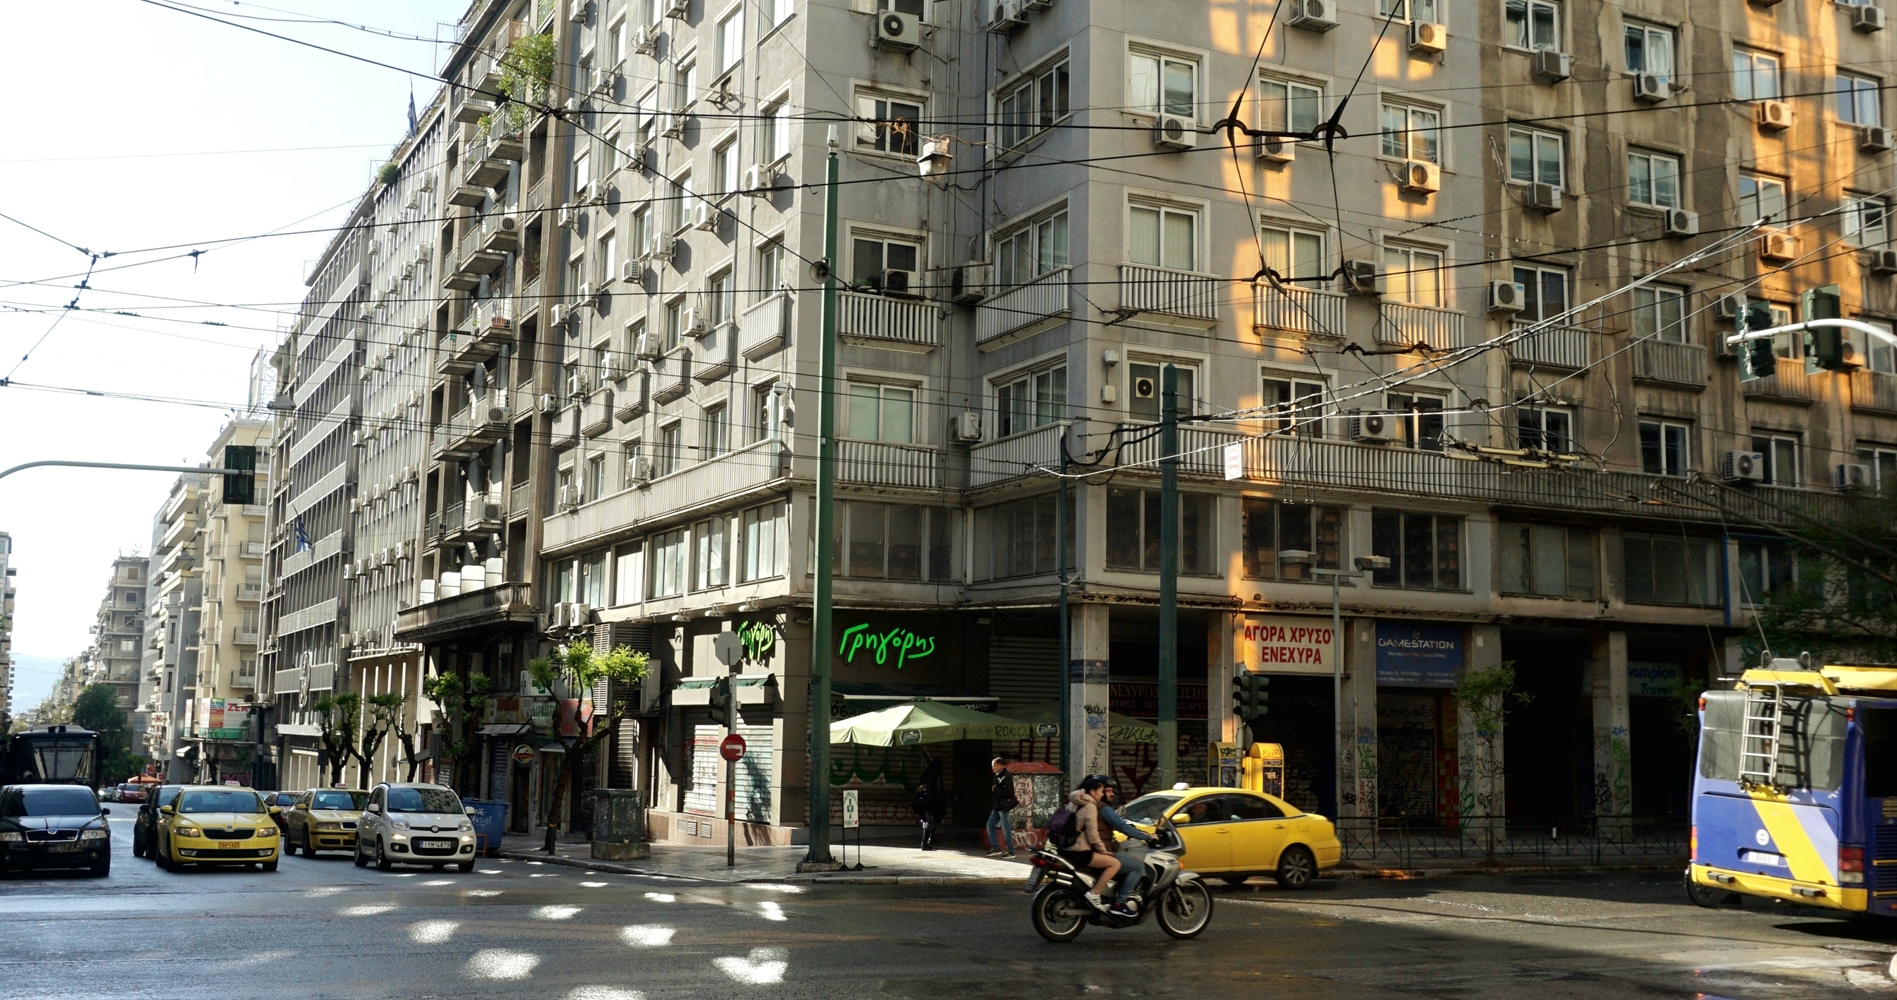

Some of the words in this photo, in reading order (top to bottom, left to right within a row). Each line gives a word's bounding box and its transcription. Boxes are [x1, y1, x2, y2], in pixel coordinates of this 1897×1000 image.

[1244, 625, 1286, 642] ΑΓΟΡΑ
[839, 622, 936, 669] Γρηγόρης
[1378, 638, 1454, 649] GAMESTATION
[1261, 646, 1322, 664] ΕΝΕΧΥΡΑ
